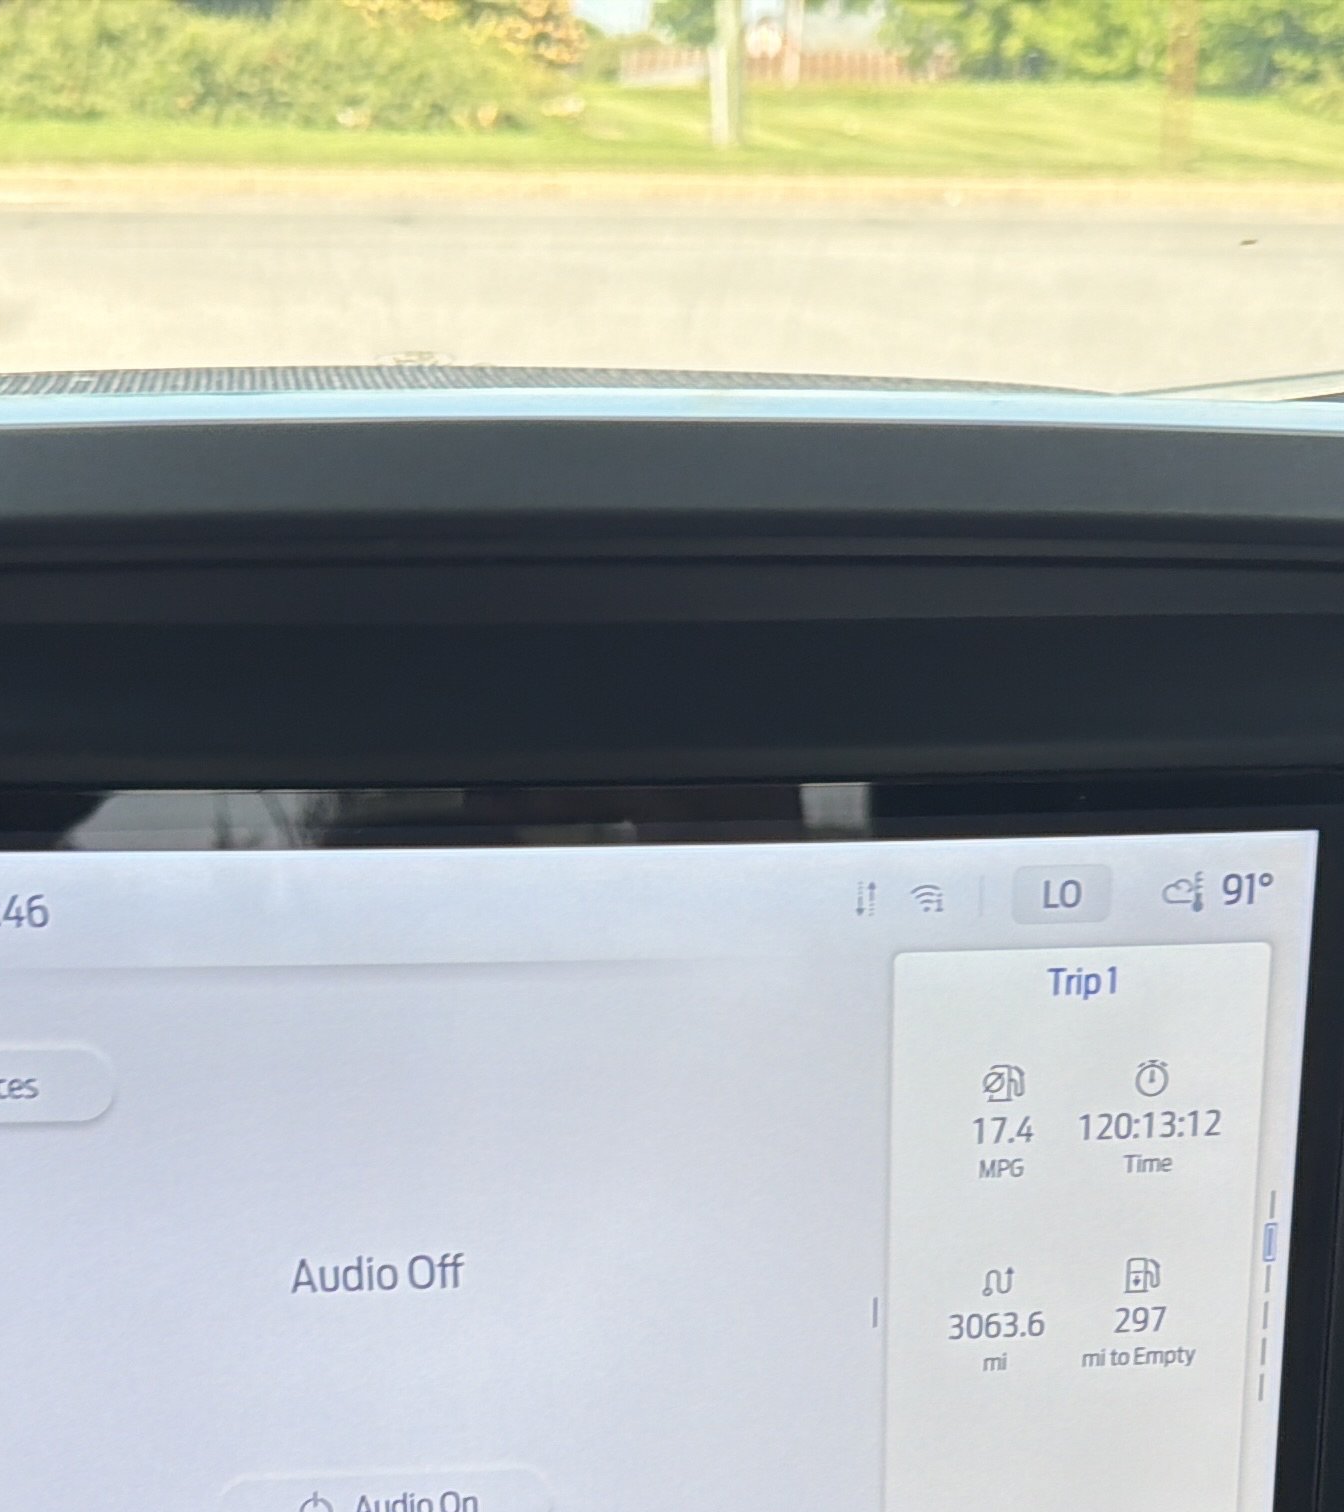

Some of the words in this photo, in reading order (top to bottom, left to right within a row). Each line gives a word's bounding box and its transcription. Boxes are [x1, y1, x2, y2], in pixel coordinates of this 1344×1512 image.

[1044, 880, 1081, 908] LO
[1047, 968, 1101, 1000] Trip
[1108, 966, 1116, 994] 1
[973, 1116, 1034, 1144] 17.4
[1080, 1109, 1220, 1140] 120:13:12
[979, 1158, 1024, 1178] MPG
[1123, 1154, 1172, 1173] Time
[292, 1256, 398, 1293] Audio
[408, 1253, 464, 1289] Off
[949, 1311, 1044, 1339] 3063.6
[1114, 1306, 1166, 1333] 297
[983, 1353, 1007, 1371] mi
[1082, 1349, 1105, 1367] mi
[1110, 1350, 1130, 1366] to
[1134, 1347, 1196, 1368] Empty
